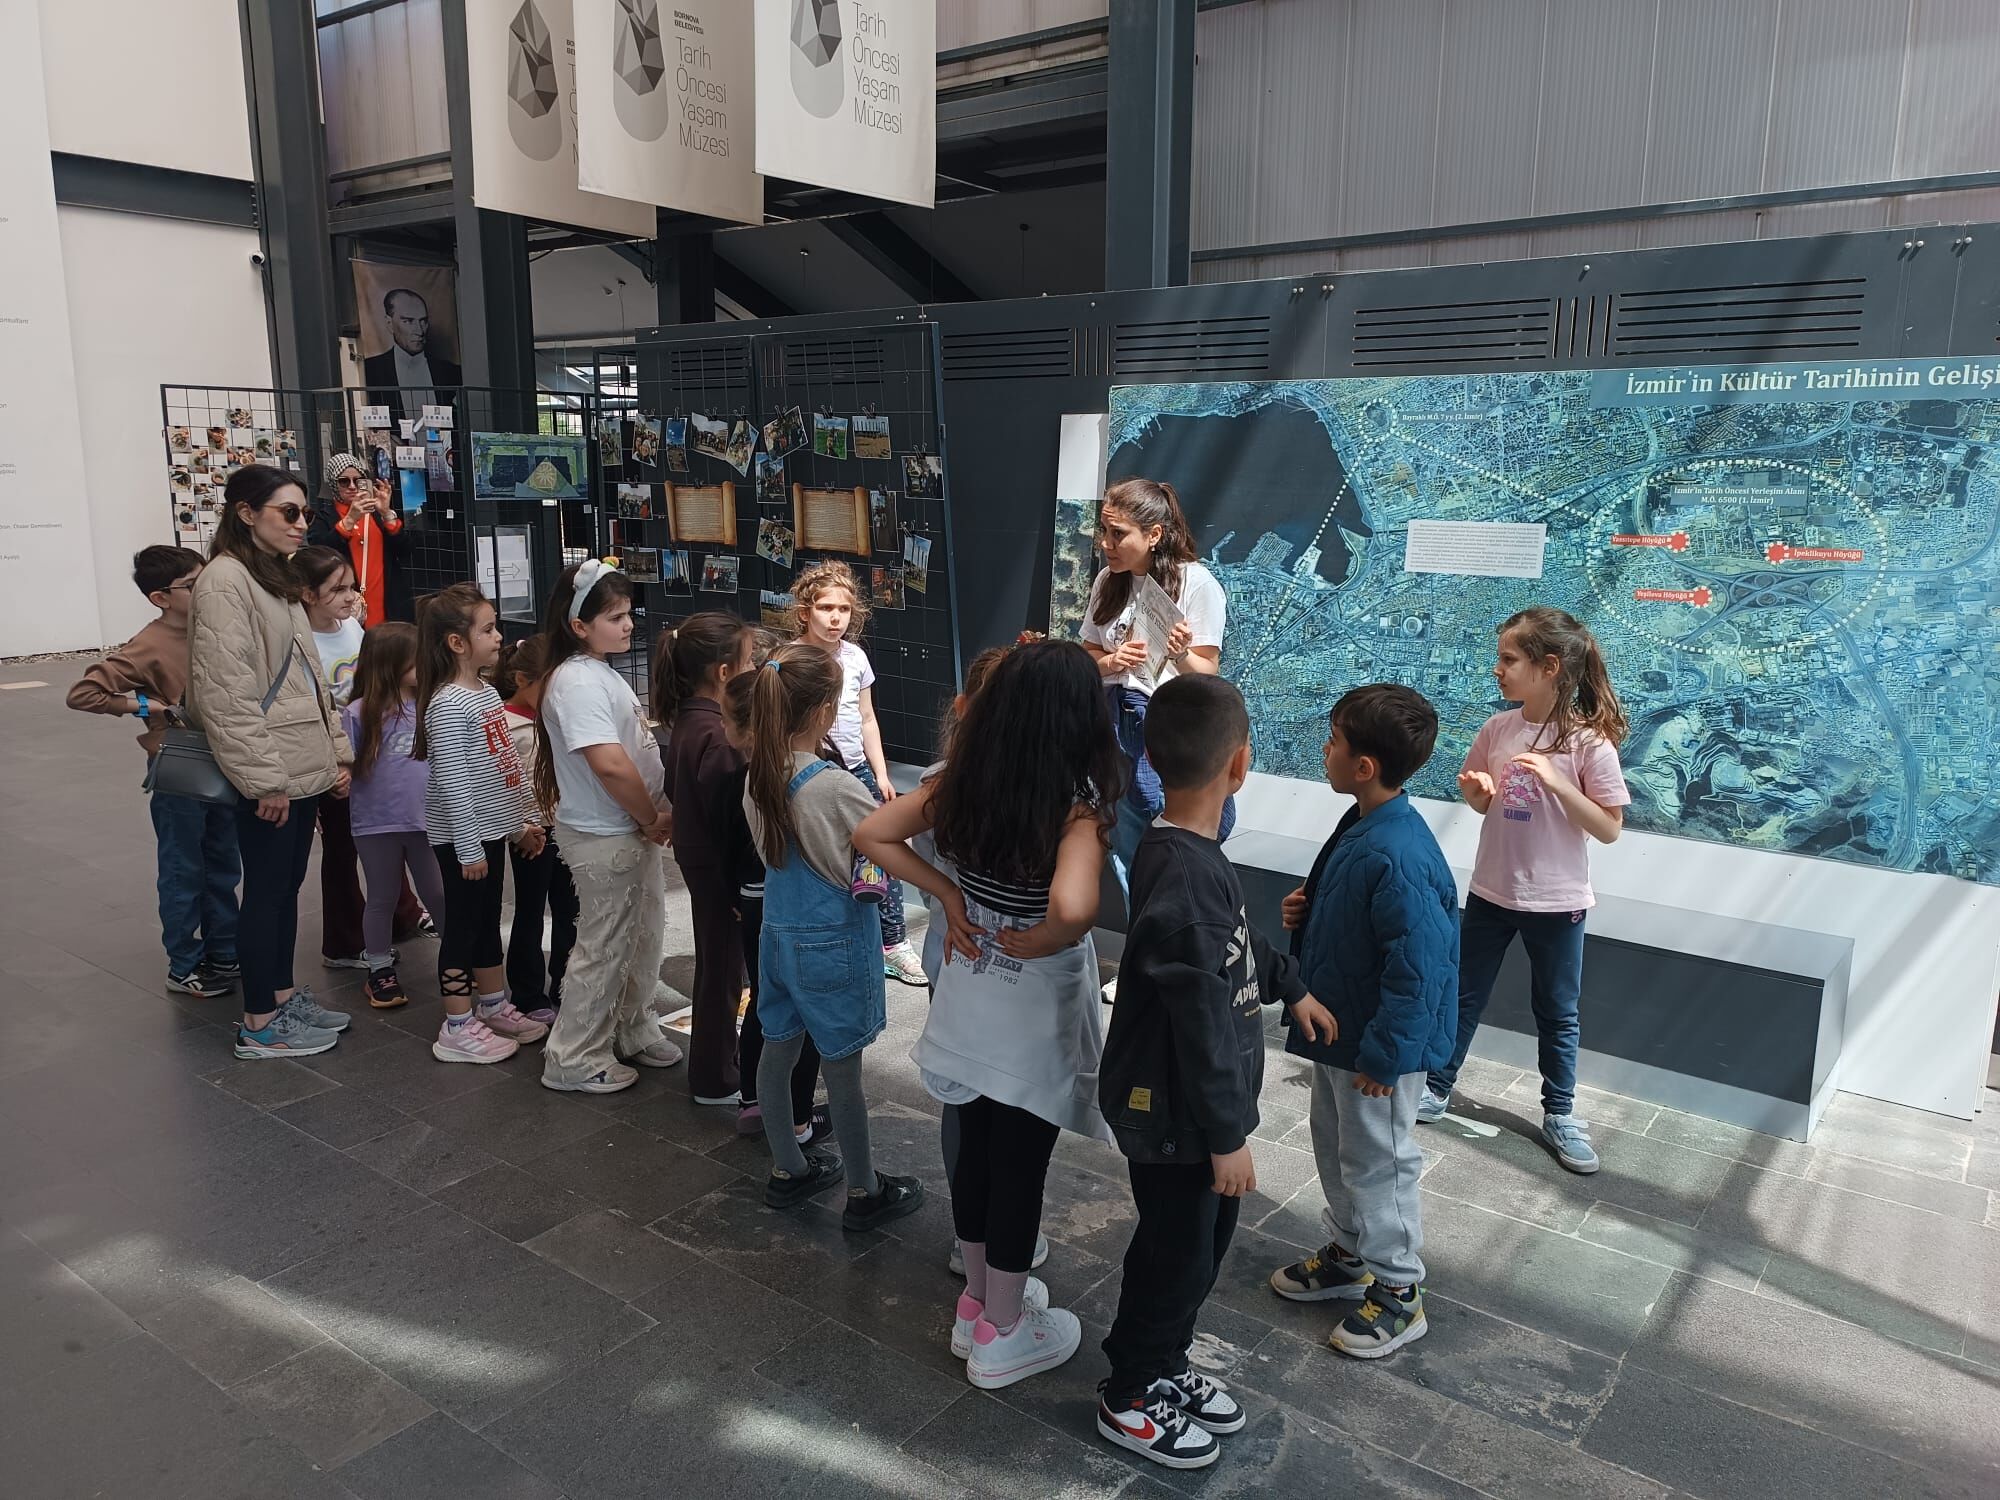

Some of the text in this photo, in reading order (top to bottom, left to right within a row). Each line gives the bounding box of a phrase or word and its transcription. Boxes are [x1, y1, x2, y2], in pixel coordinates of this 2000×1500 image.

[852, 1, 887, 40] Tarih
[675, 36, 711, 71] Tarih
[853, 32, 900, 77] Öncesi
[677, 63, 727, 104] Öncesi
[854, 65, 900, 105] Yaşam
[678, 94, 727, 130] Yaşam
[855, 96, 902, 135] Müzesi
[680, 122, 730, 158] Müzesi
[1719, 371, 1797, 392] Kültür
[1803, 367, 1920, 389] Tarihinin
[1701, 495, 1717, 504] M.Ö.
[1718, 496, 1737, 504] 6500
[1750, 496, 1774, 505] İzmir)
[1724, 486, 1749, 494] Öncesi
[1751, 487, 1784, 496] Yerleşim
[1833, 551, 1861, 560] Höyüğü
[1000, 973, 1018, 985] 1982
